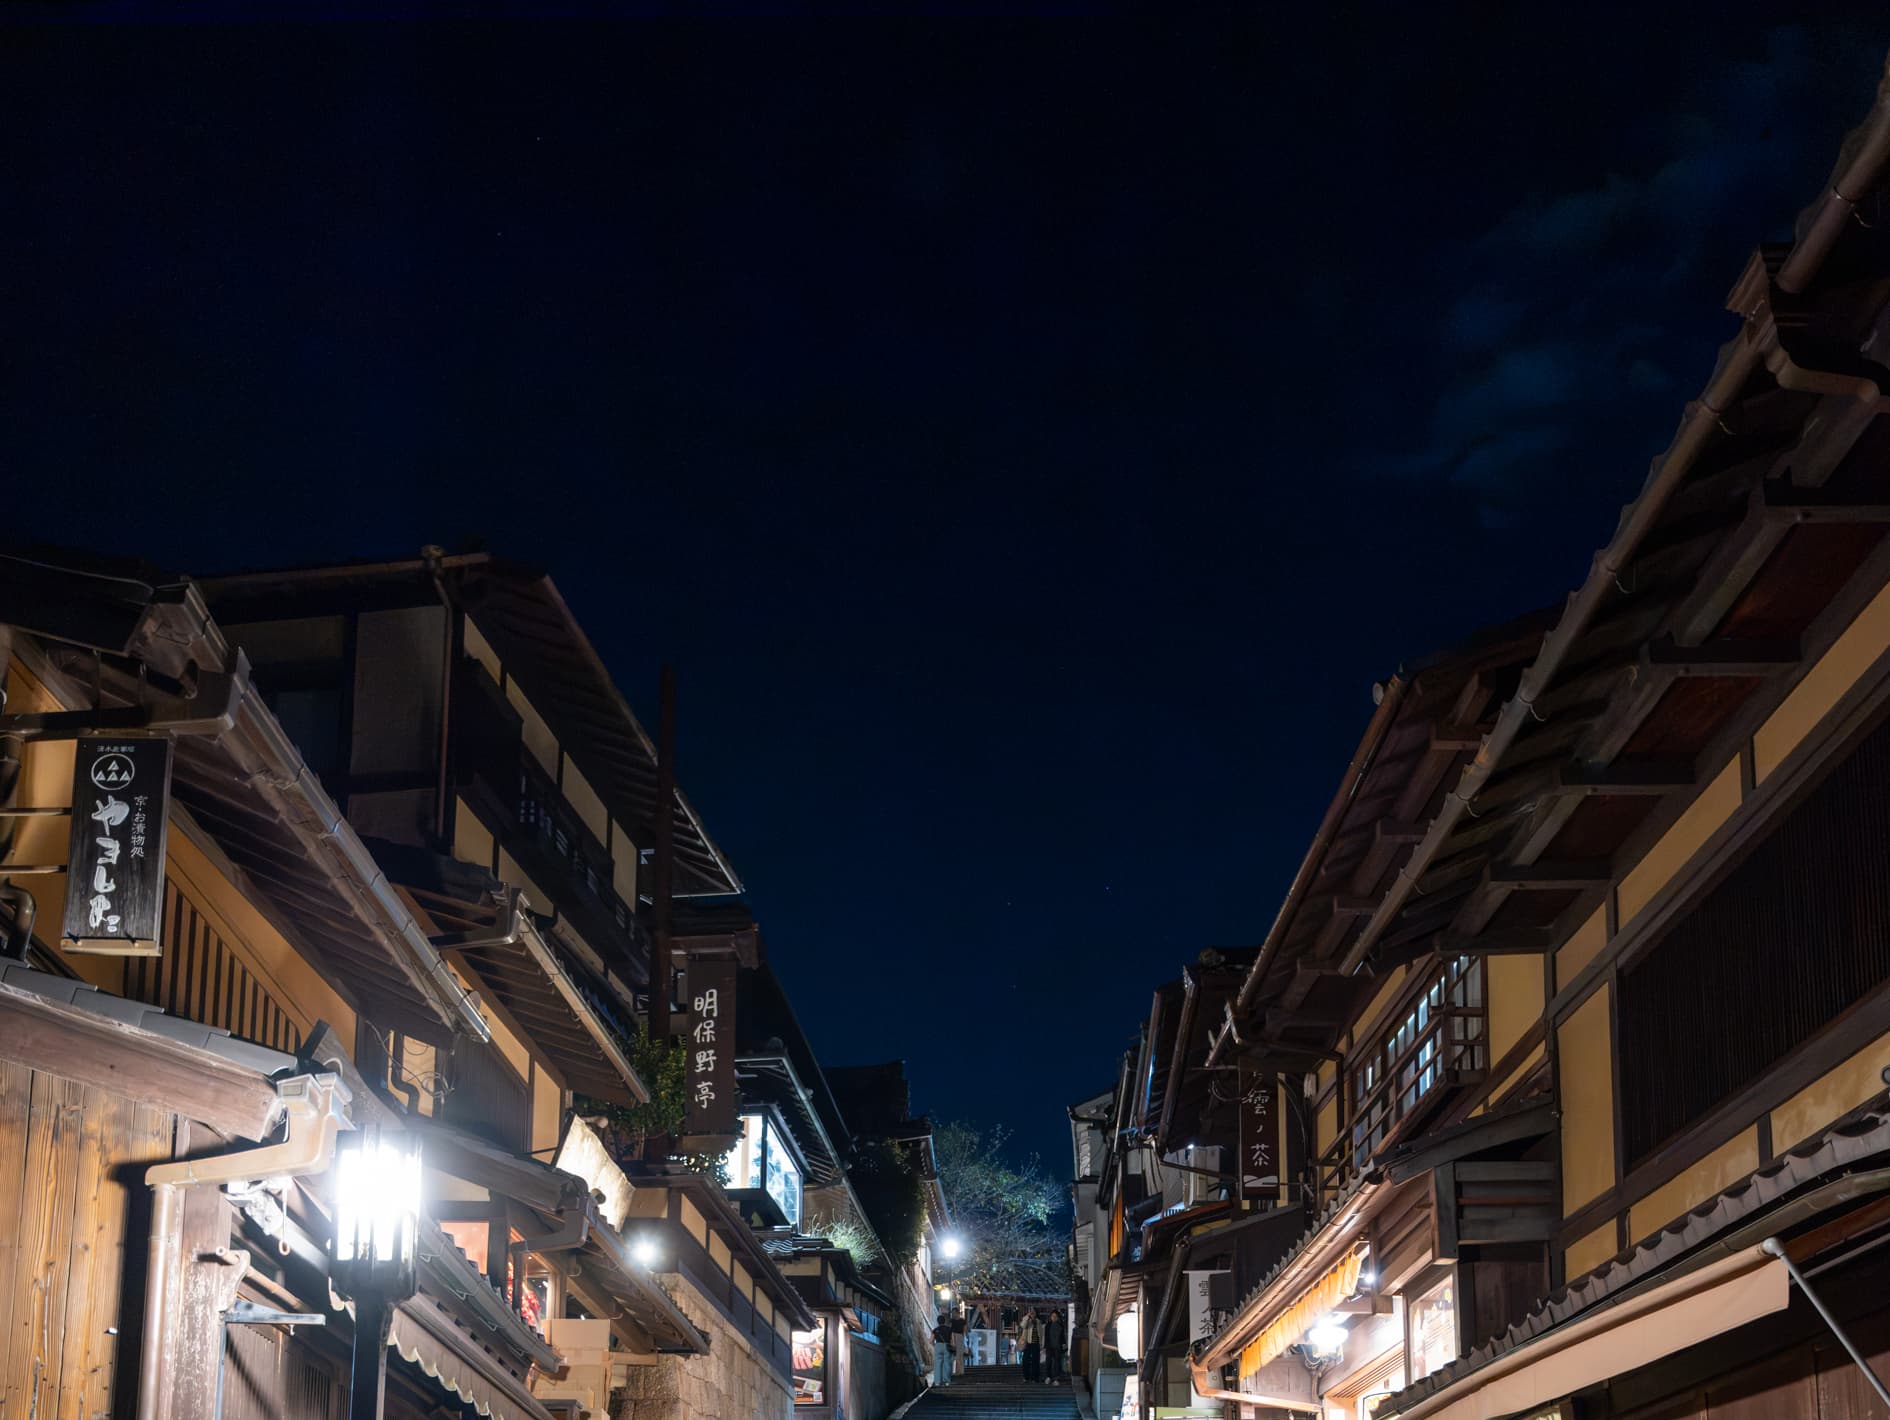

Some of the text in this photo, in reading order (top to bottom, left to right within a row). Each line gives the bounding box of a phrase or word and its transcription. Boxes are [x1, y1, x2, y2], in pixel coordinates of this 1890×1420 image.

[693, 988, 718, 1109] 明保野亭
[1250, 1089, 1271, 1167] 雲ノ茶
